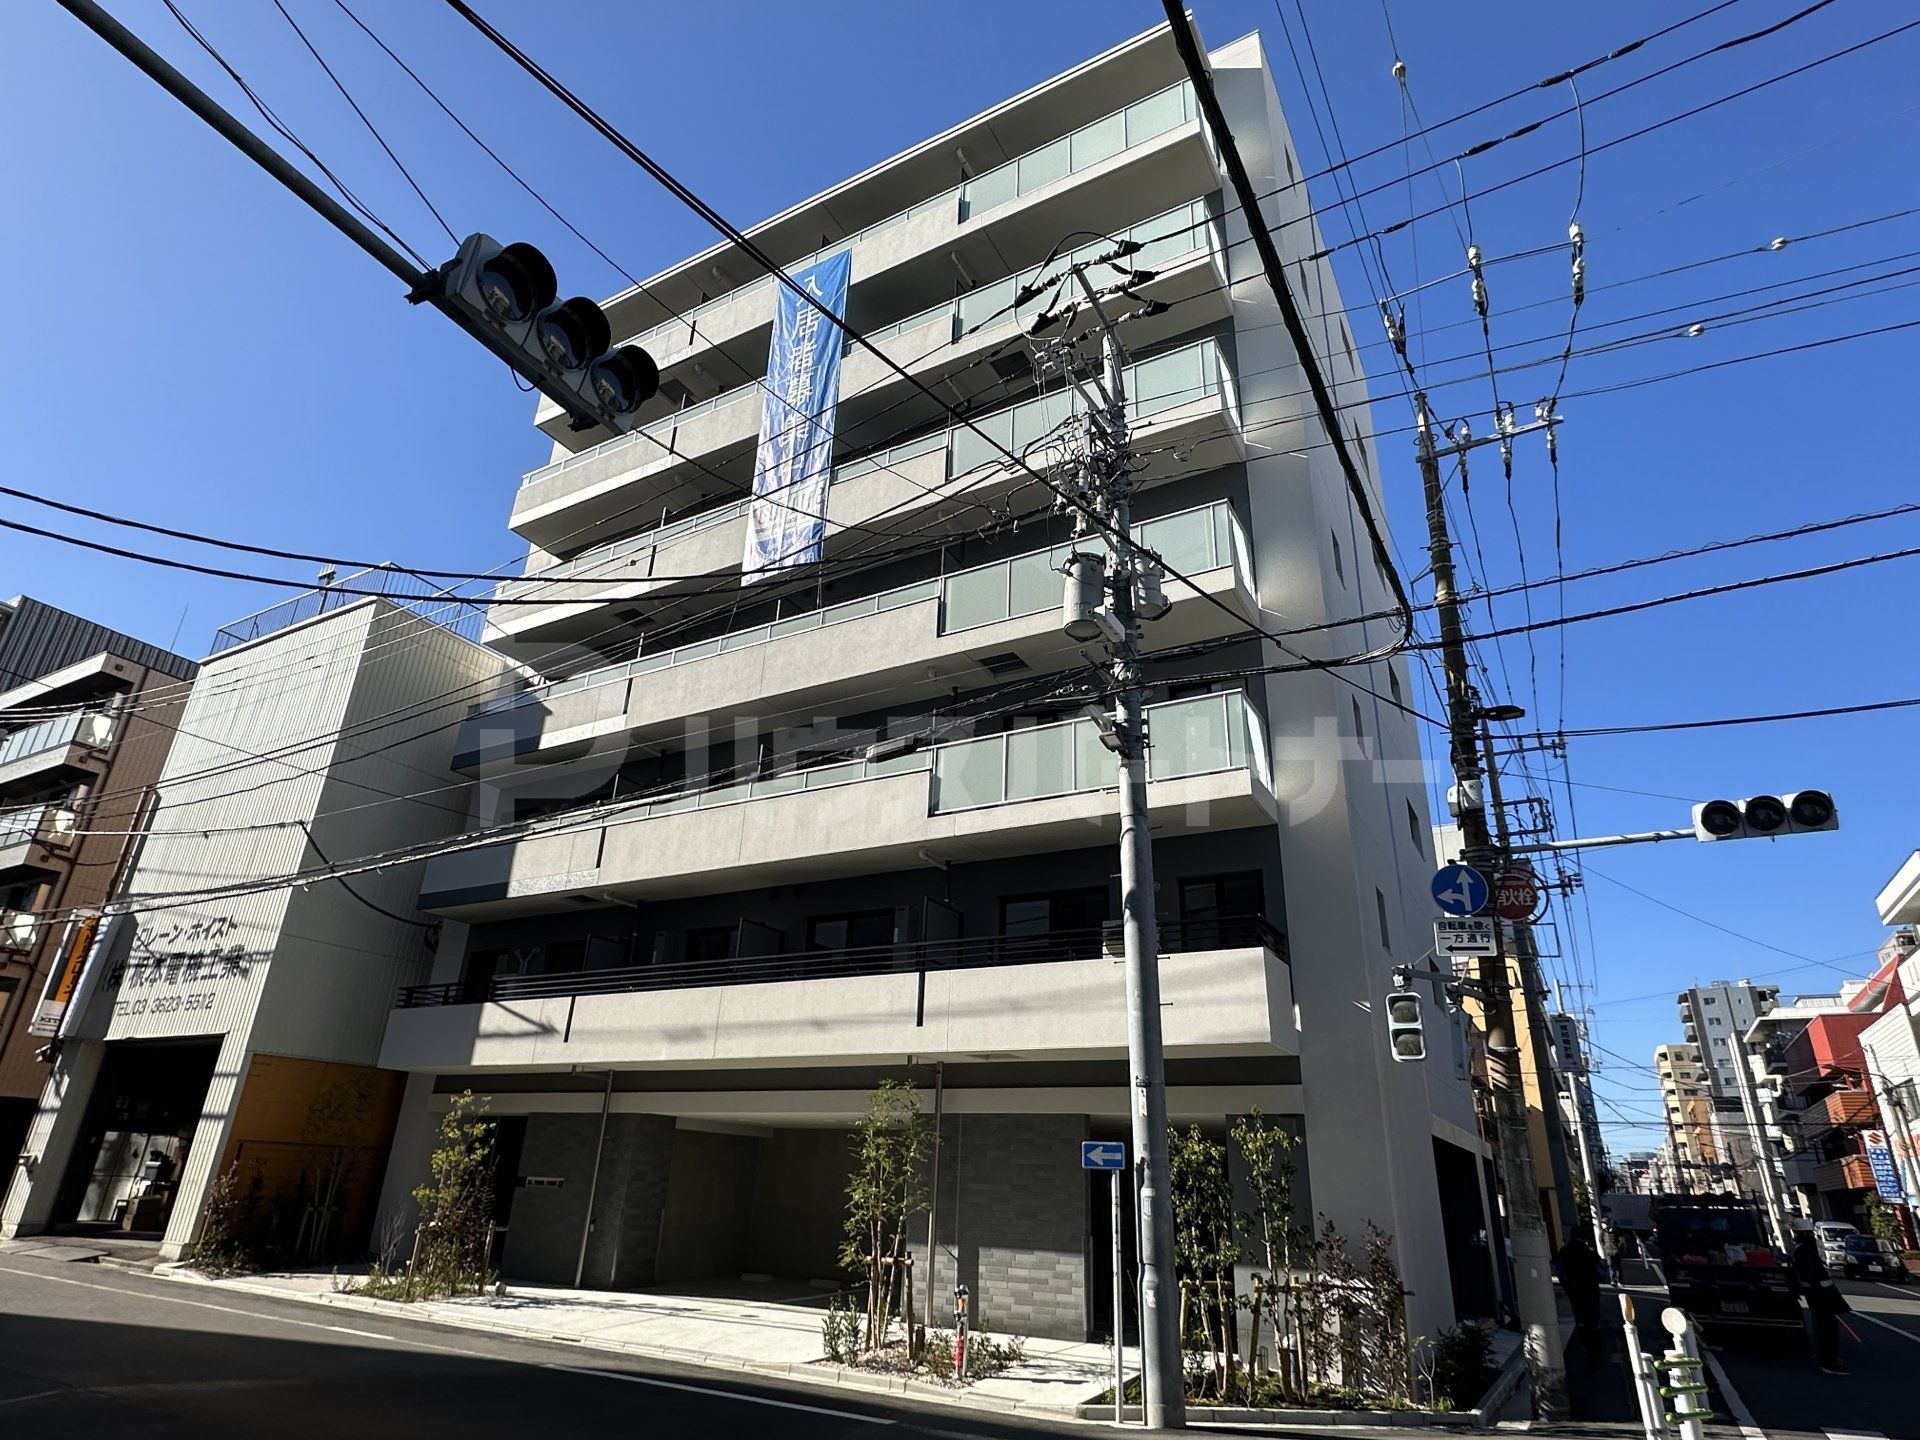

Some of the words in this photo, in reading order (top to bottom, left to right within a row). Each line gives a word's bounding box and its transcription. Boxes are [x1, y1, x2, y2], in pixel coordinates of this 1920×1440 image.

[1438, 921, 1491, 931] 自転車を除く
[1440, 933, 1491, 944] 一方通行
